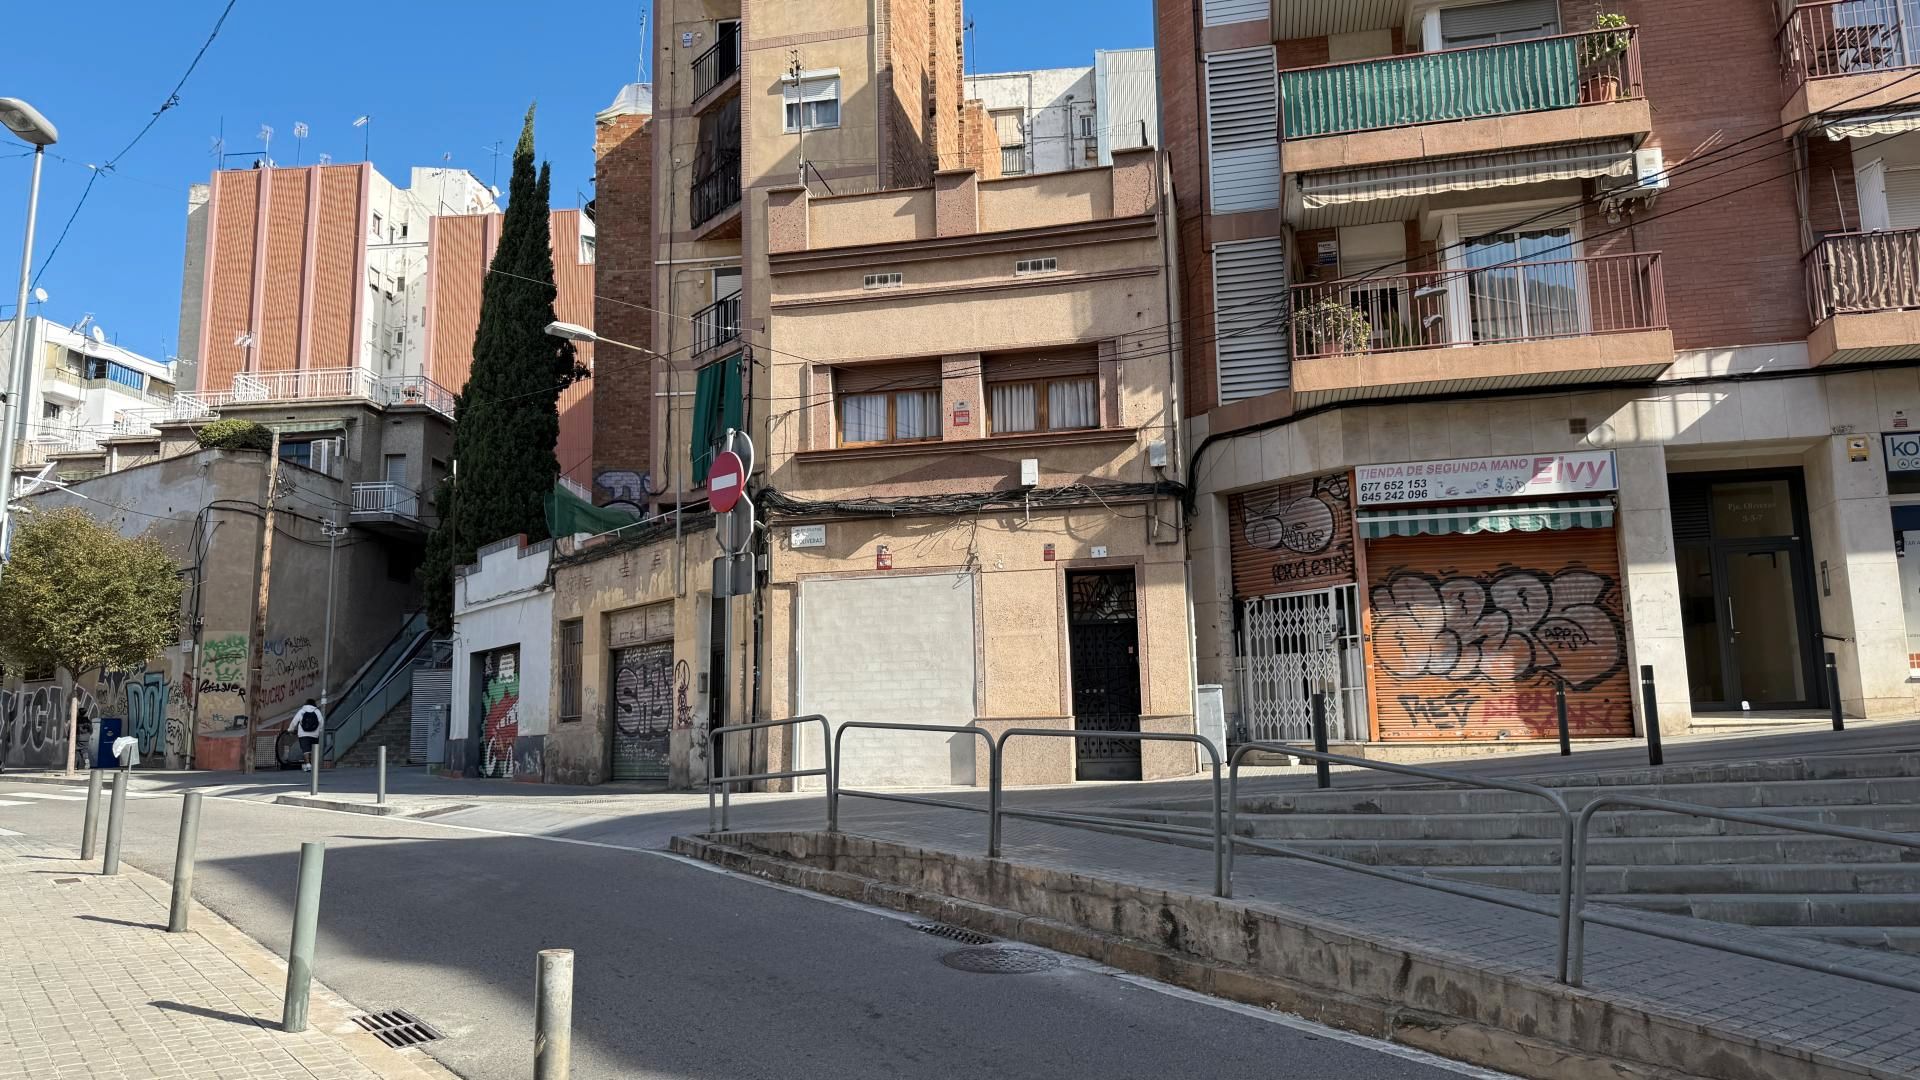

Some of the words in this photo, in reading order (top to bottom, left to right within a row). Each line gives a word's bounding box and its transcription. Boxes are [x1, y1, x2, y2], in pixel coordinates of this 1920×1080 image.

[1890, 436, 1920, 457] ko
[1359, 464, 1405, 480] TIENDA
[1407, 464, 1423, 477] DE
[1426, 461, 1488, 475] SEGUNDA
[1490, 458, 1529, 471] MANO
[1360, 481, 1381, 492] 677
[1384, 480, 1403, 491] 652
[1407, 479, 1427, 490] 153
[1361, 492, 1383, 502] 645
[1384, 490, 1405, 501] 242
[1408, 489, 1428, 500] 096
